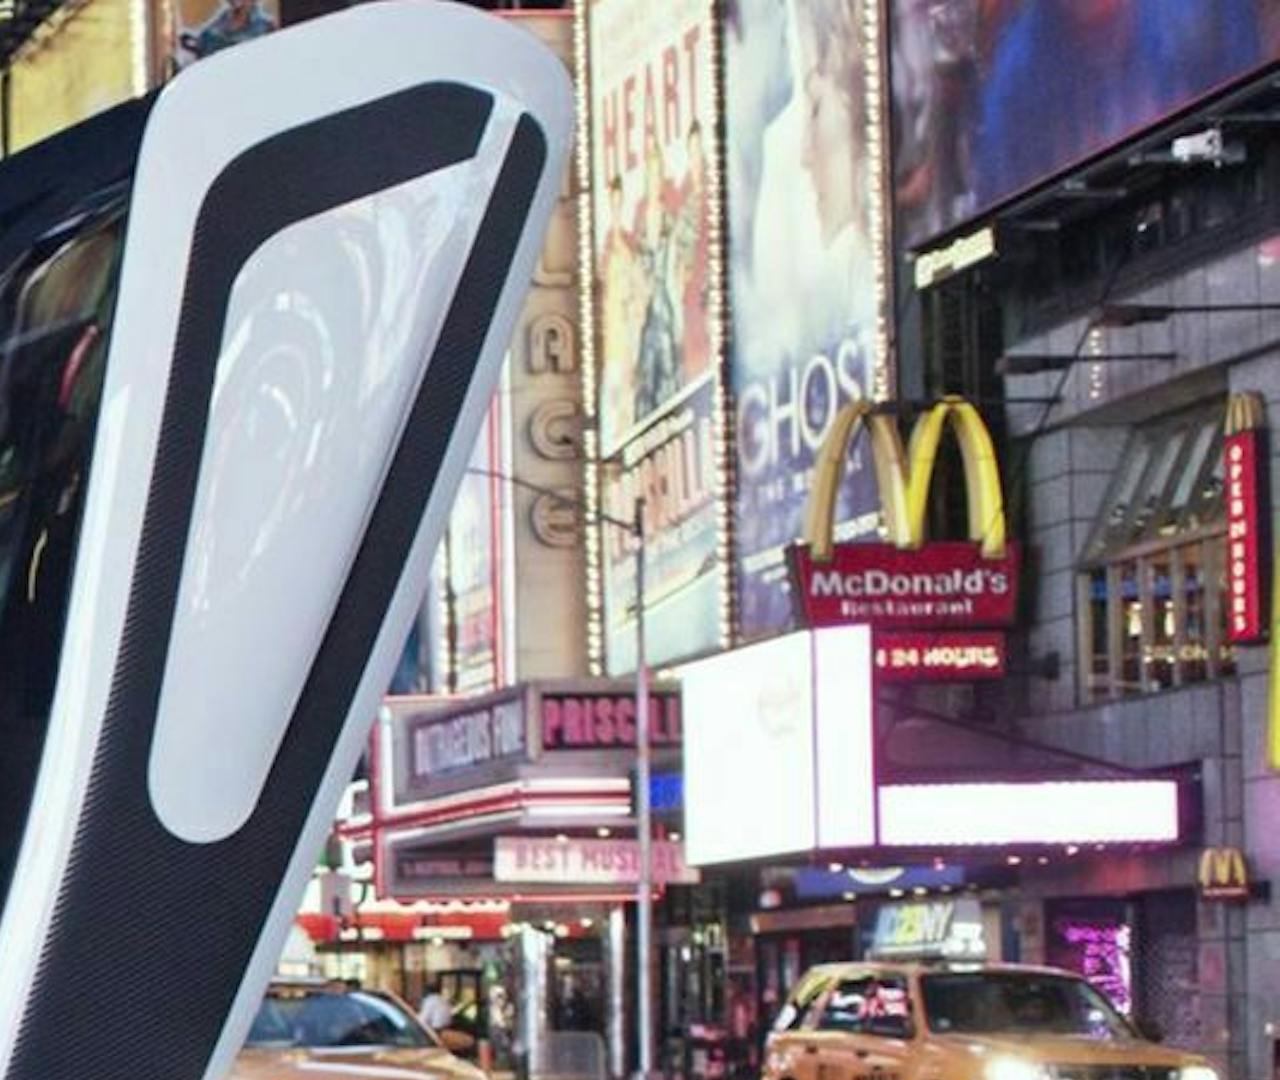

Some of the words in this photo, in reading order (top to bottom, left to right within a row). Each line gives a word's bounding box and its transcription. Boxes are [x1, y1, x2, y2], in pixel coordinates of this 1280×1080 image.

[603, 24, 700, 192] HEART
[810, 569, 1008, 597] McDonald's
[841, 598, 973, 617] Restaurant
[890, 648, 919, 667] 24
[923, 645, 999, 668] HOURS
